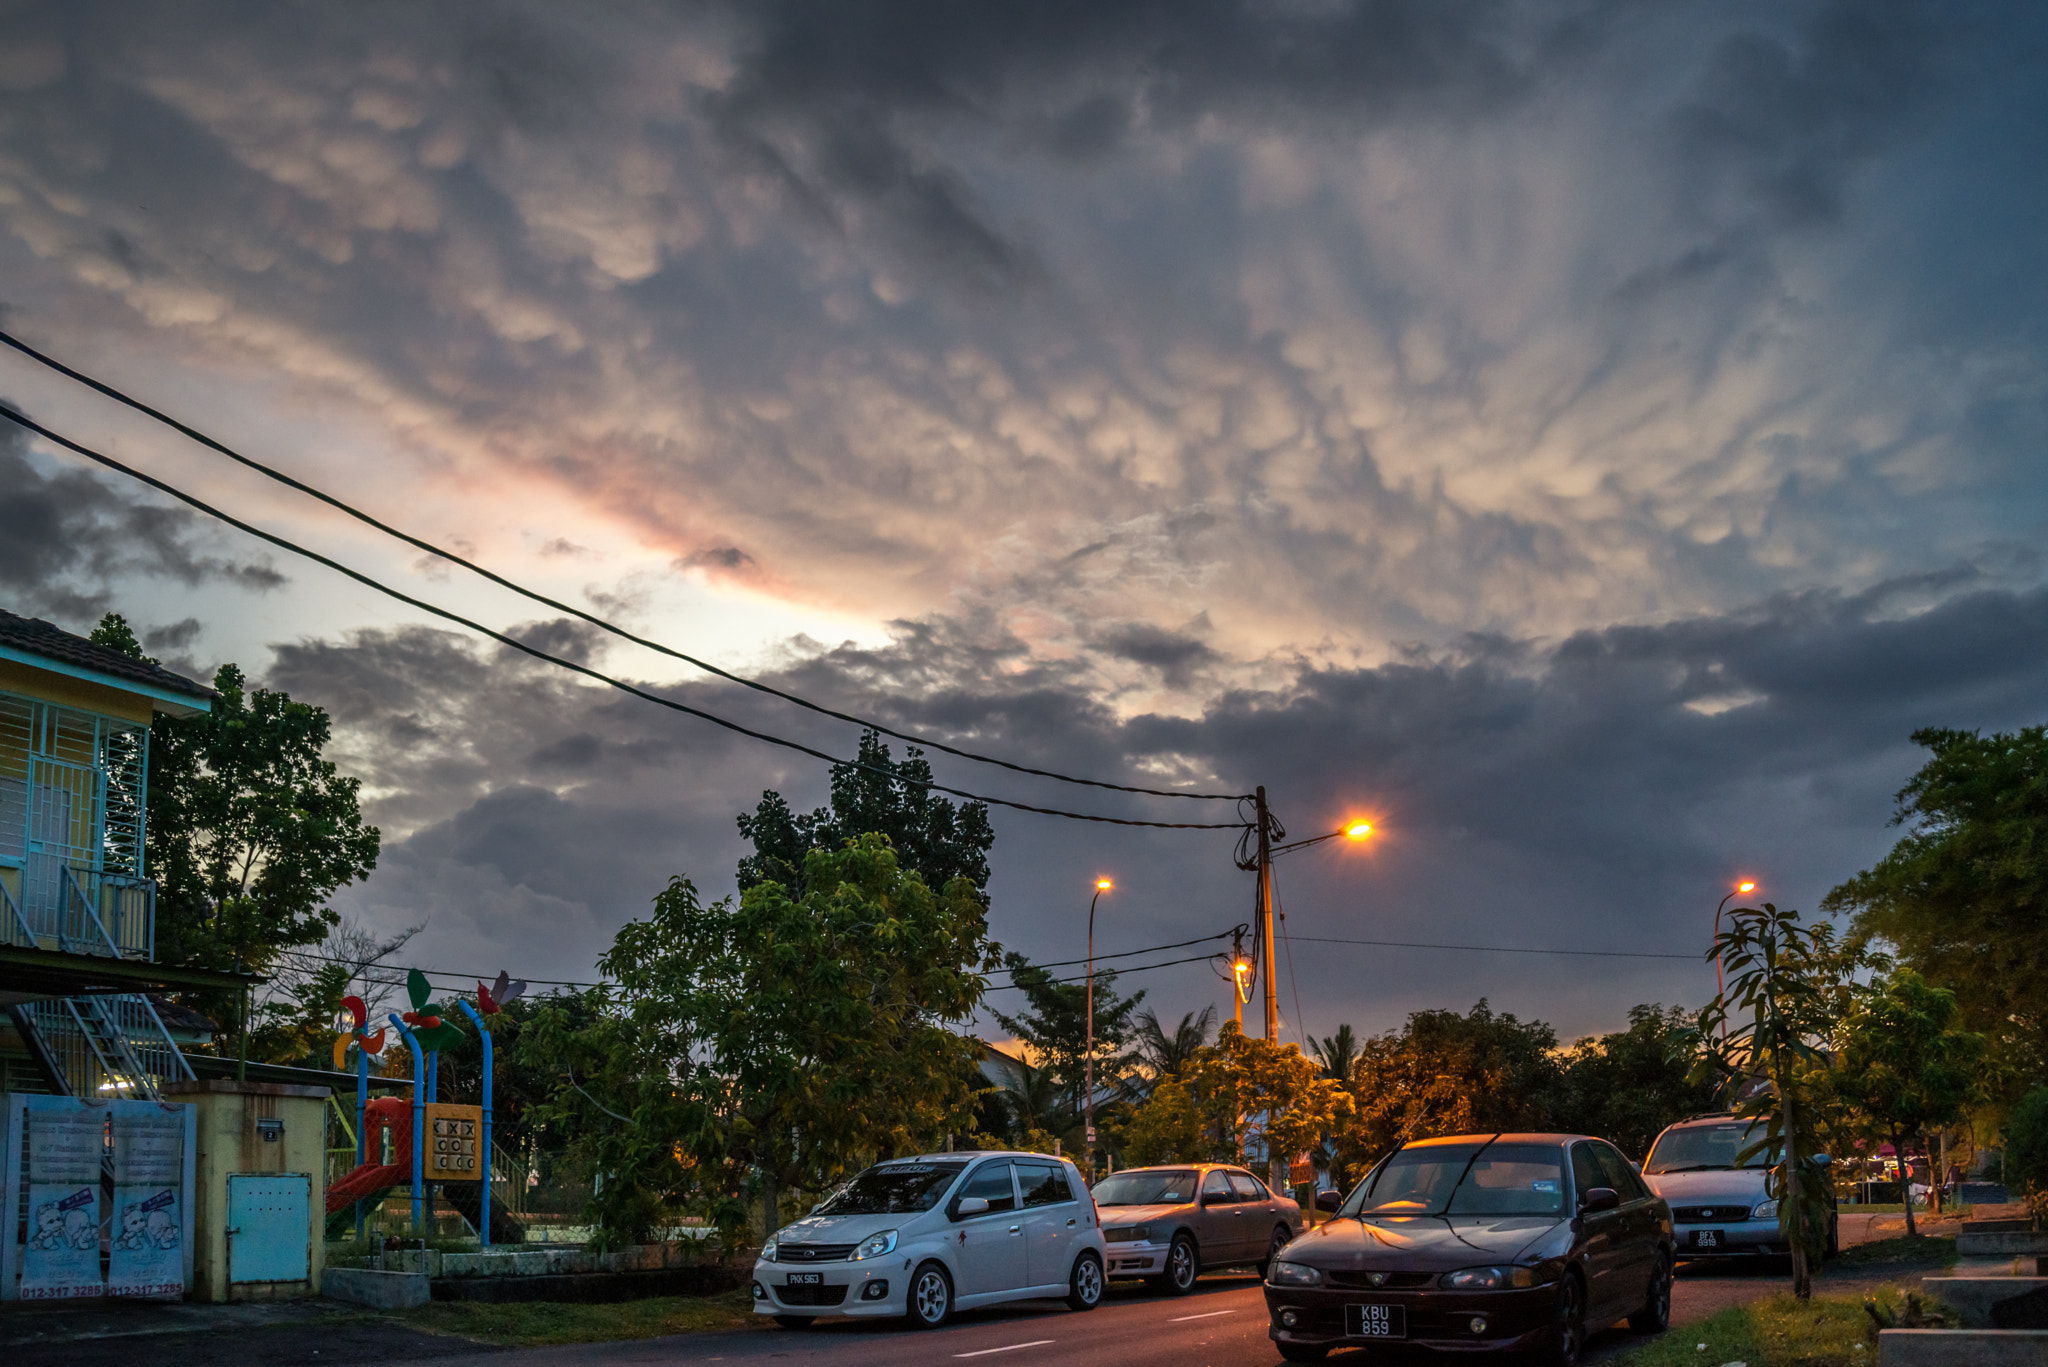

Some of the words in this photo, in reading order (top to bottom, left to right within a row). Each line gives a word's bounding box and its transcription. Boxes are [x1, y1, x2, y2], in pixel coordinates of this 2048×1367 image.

[1699, 1231, 1714, 1239] BFX
[790, 1274, 804, 1284] PKK
[22, 1286, 69, 1298] 012-317
[73, 1285, 101, 1296] 3285
[110, 1285, 152, 1296] 012-317
[156, 1283, 182, 1294] 3285
[1361, 1306, 1389, 1320] KBU
[1362, 1320, 1389, 1335] 859
